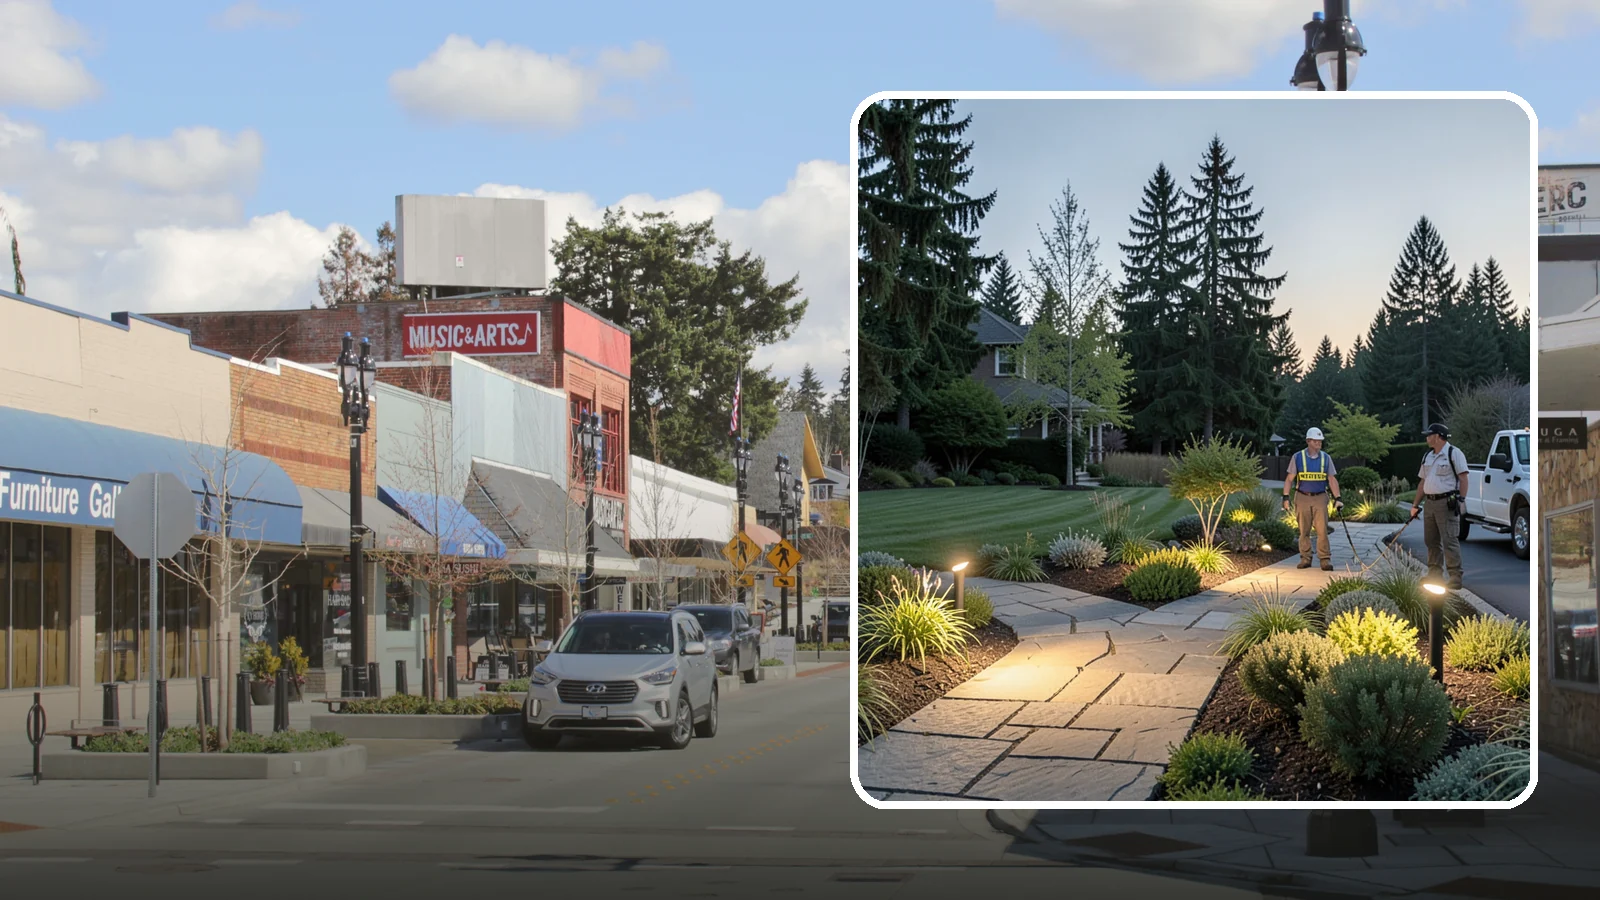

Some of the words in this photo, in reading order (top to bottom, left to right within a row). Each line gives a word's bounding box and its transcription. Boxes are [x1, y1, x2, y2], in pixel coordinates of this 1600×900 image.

[409, 322, 519, 348] MUSIC&ARTS
[0, 471, 79, 515] Furniture
[89, 482, 122, 518] Gal
[453, 563, 479, 574] SUSHI
